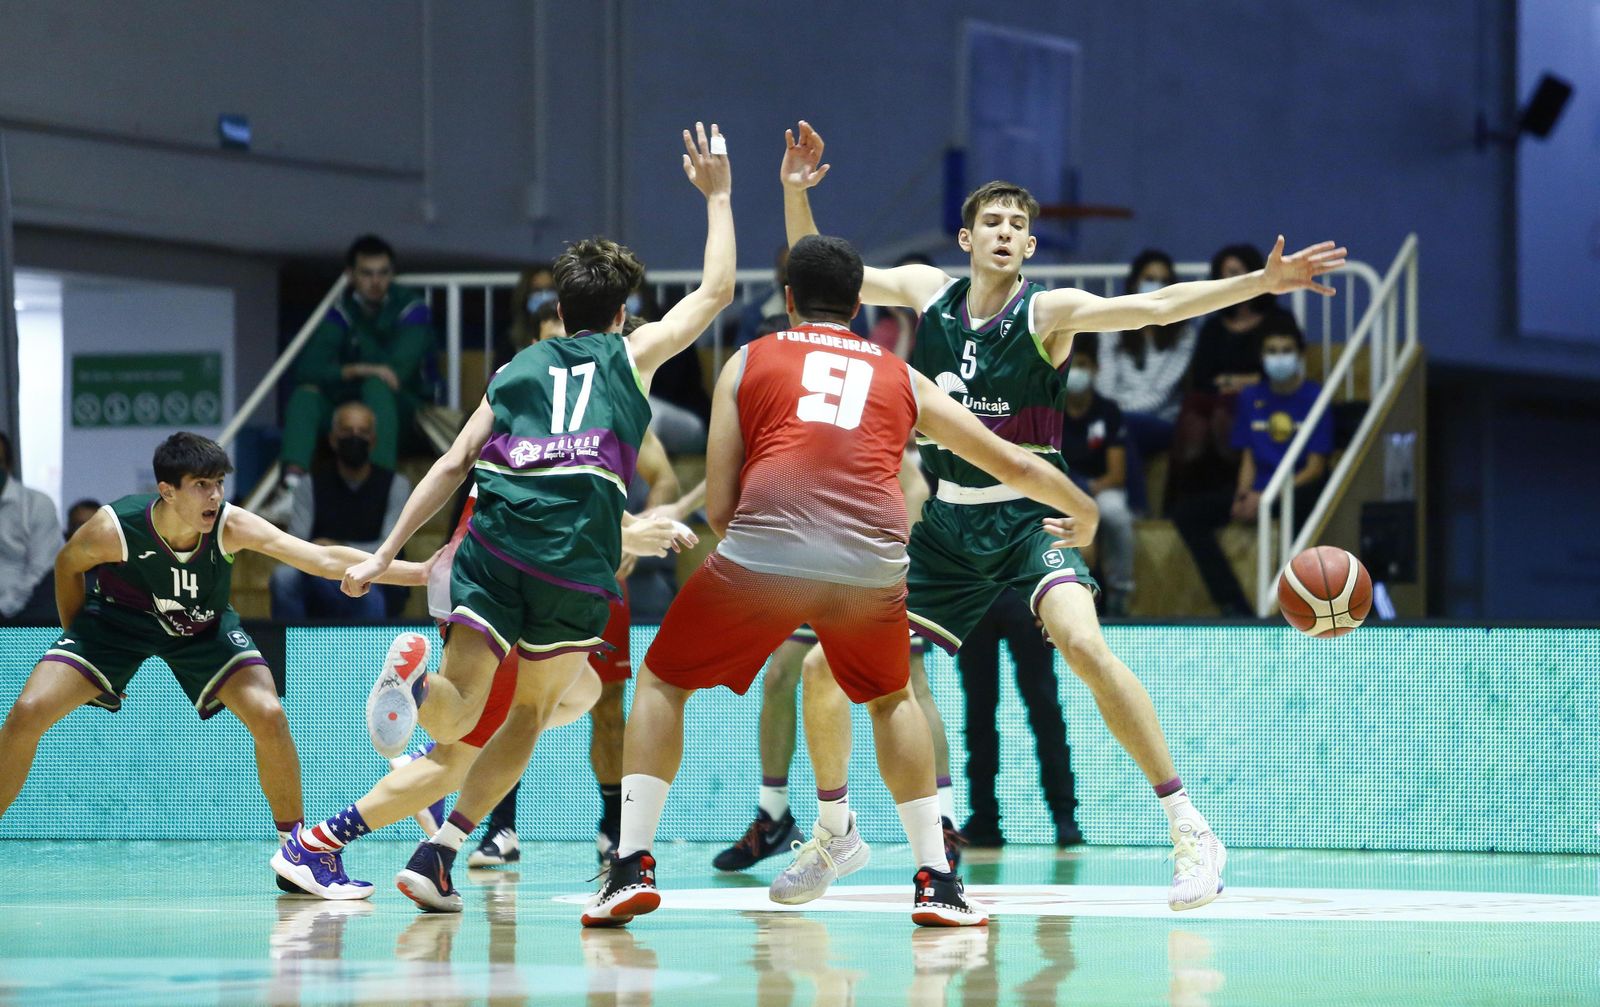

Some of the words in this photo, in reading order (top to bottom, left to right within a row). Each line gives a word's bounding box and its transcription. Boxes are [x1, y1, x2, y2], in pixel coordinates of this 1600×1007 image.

[777, 331, 882, 356] FOLGUEIRAS
[960, 340, 977, 380] 5
[548, 361, 596, 434] 17
[796, 350, 874, 430] 9
[962, 395, 1010, 414] Unicaja
[170, 566, 199, 599] 14
